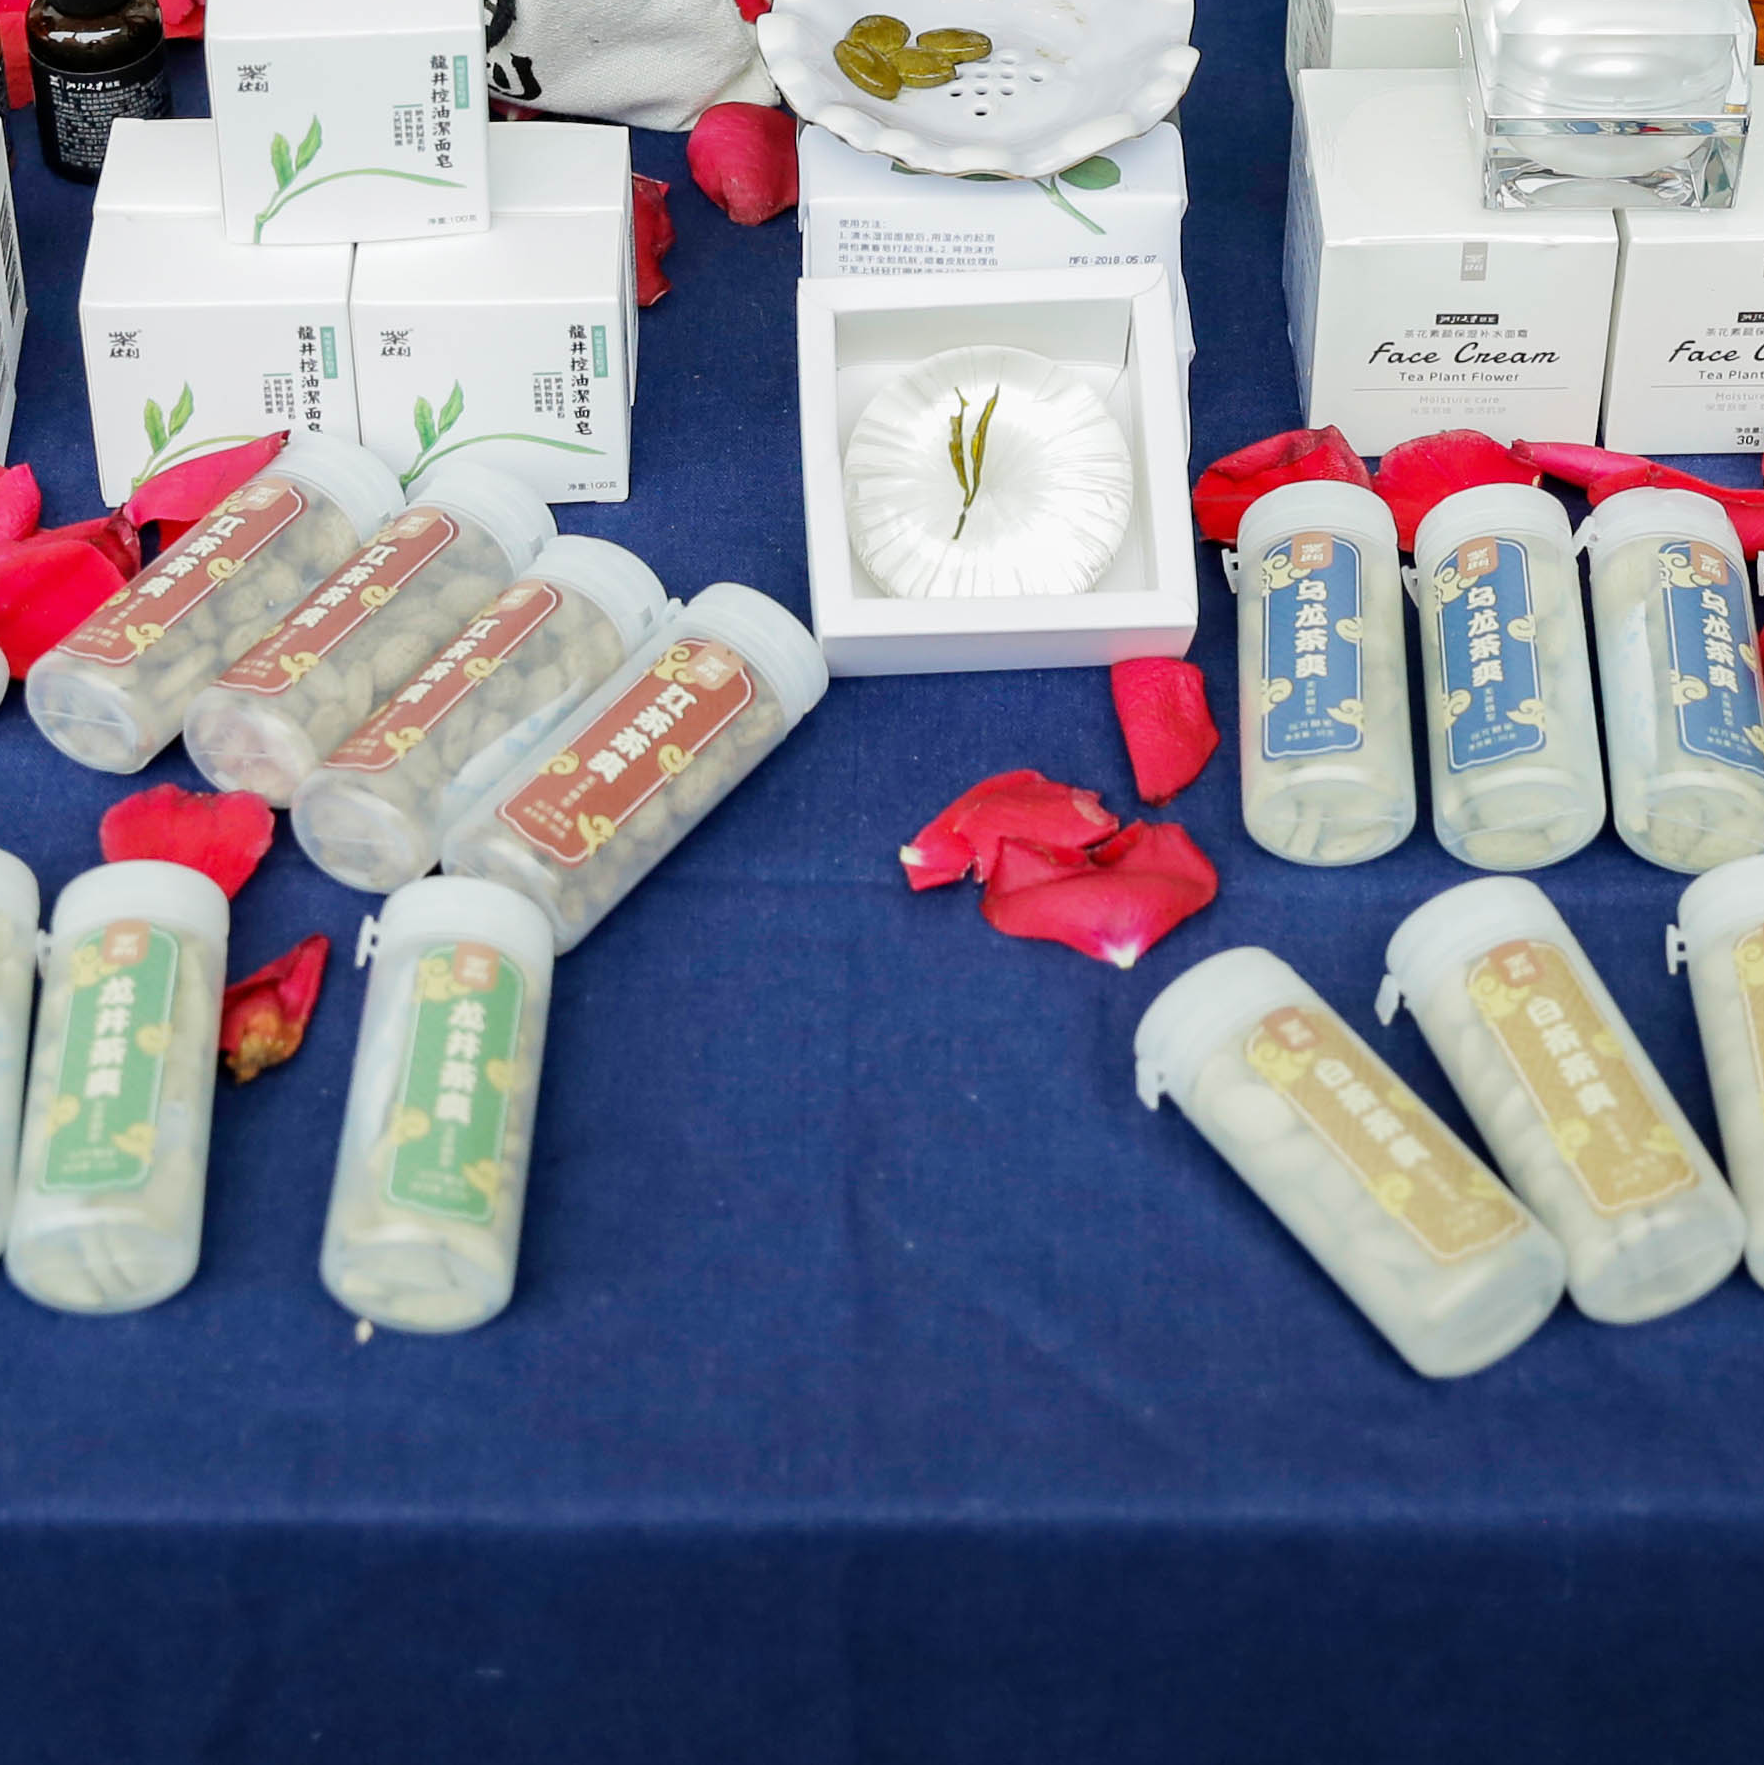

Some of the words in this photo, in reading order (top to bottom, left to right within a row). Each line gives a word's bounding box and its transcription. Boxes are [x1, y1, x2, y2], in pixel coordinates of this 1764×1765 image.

[1368, 341, 1440, 363] Face
[1455, 341, 1560, 363] Cream
[1669, 340, 1740, 362] Face
[1399, 372, 1423, 381] Tea
[1429, 371, 1466, 381] Plant
[1472, 371, 1520, 381] Flower
[1699, 370, 1723, 380] Tea
[1729, 370, 1764, 379] Plant
[1737, 435, 1760, 446] 30g
[1294, 580, 1329, 679] 乌龙茶爽
[1467, 586, 1503, 687] 乌龙茶爽
[1701, 589, 1739, 694] 乌龙茶爽
[587, 683, 698, 784] 红茶茶爽
